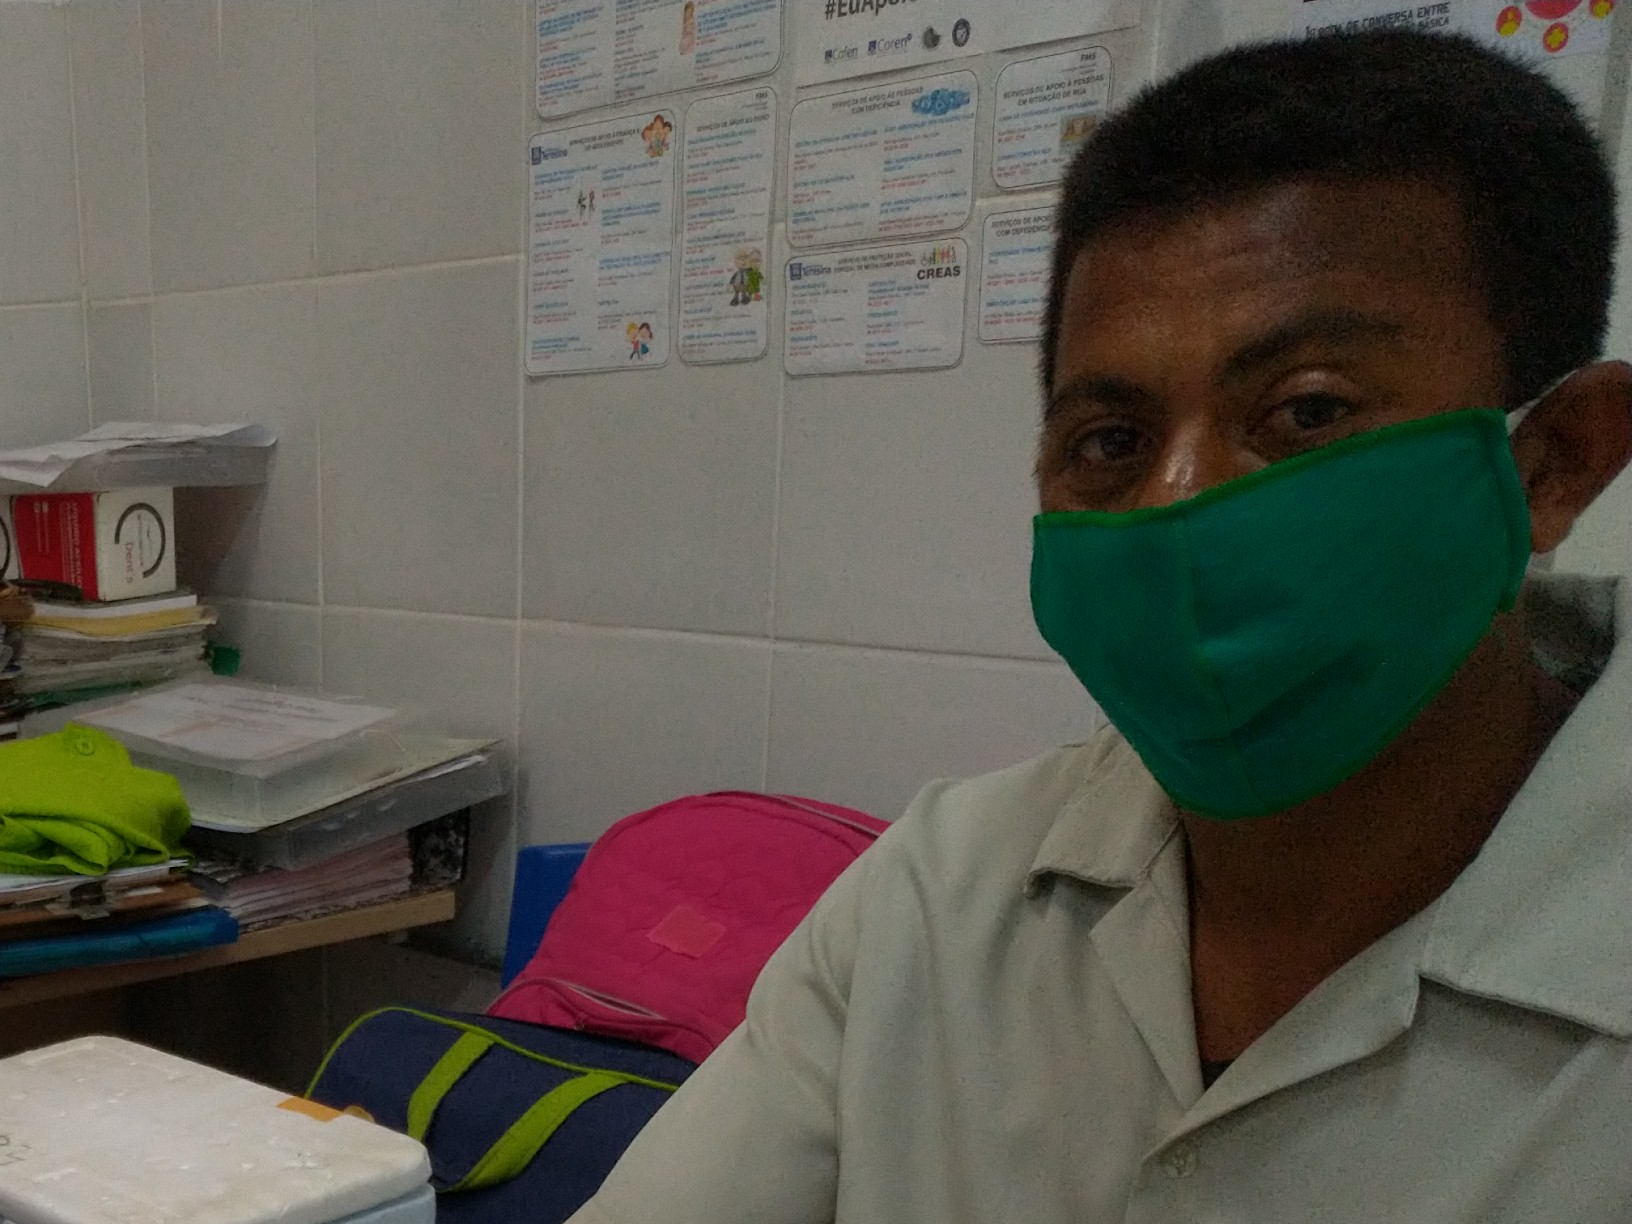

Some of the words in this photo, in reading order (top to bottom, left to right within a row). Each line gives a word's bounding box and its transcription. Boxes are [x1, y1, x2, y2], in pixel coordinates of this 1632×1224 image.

[1361, 10, 1413, 31] CONVERSA
[1417, 2, 1451, 19] ENTRE
[917, 265, 961, 280] CREAS
